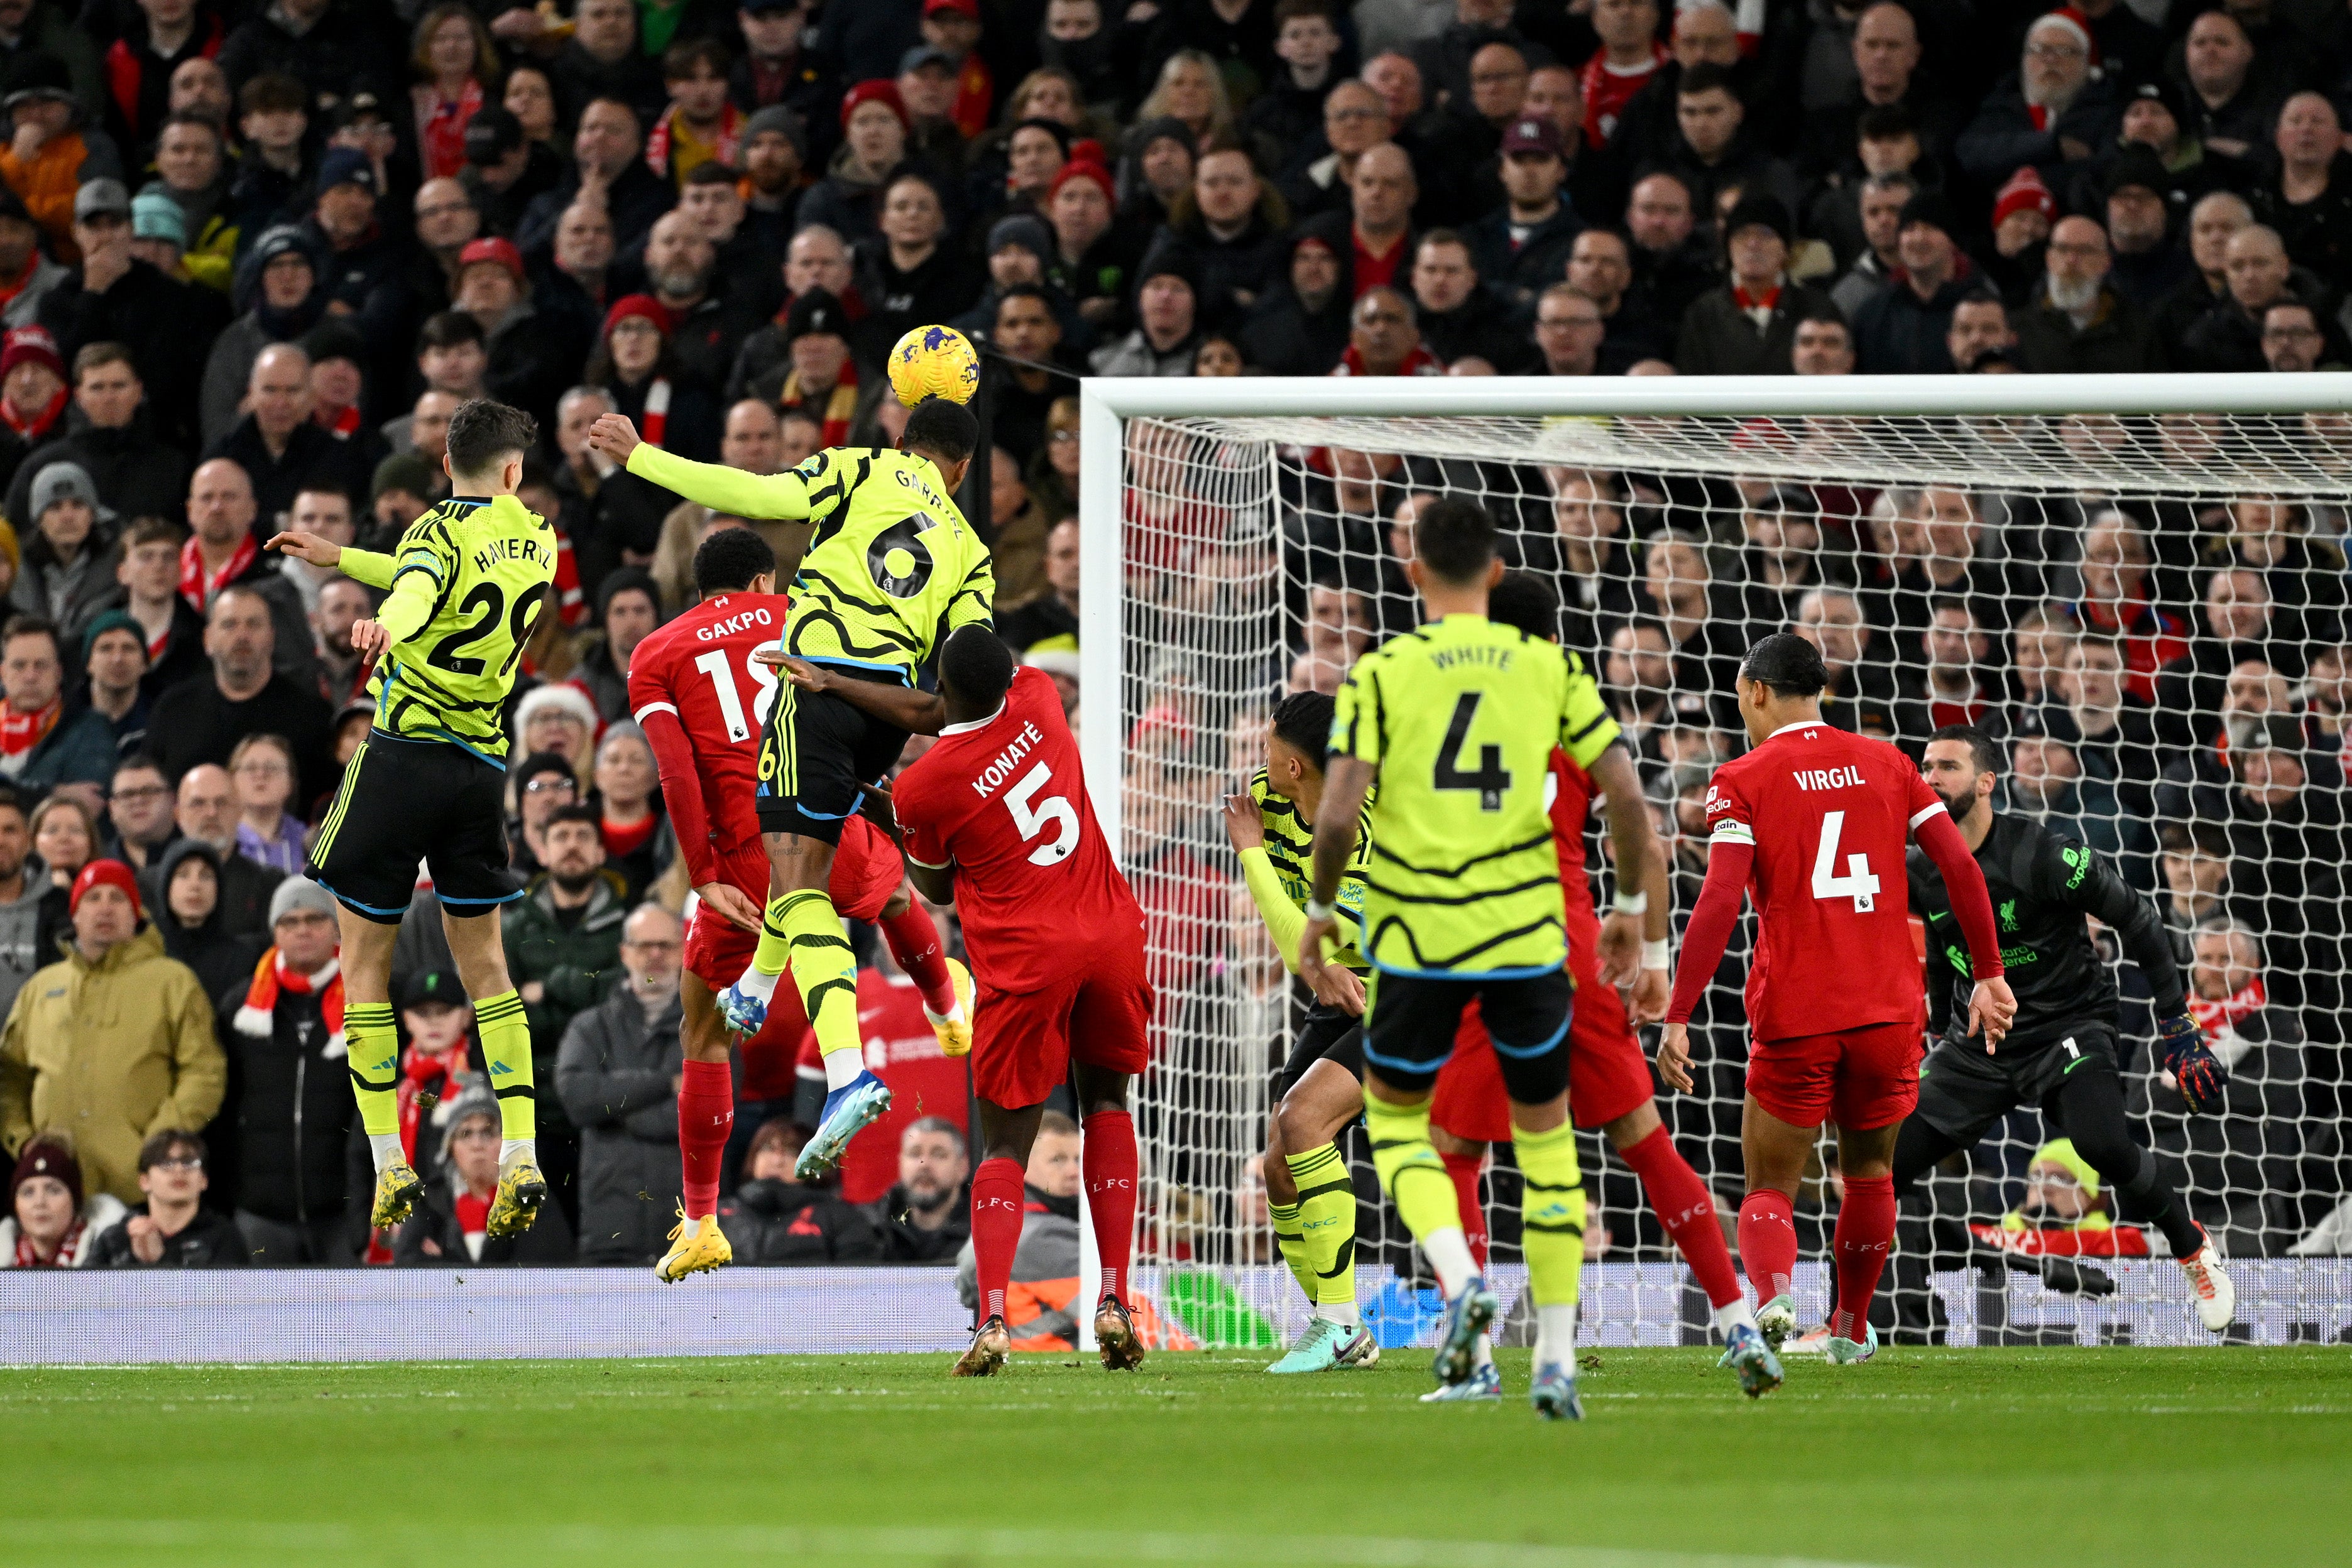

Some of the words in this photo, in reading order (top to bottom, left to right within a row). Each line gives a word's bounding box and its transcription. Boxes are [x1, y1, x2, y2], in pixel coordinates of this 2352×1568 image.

[895, 470, 965, 540] GABREL
[474, 539, 551, 574] HAVERTZ
[867, 511, 938, 599] 6
[427, 581, 550, 677] 29
[696, 608, 772, 641] GAKPO
[1430, 646, 1512, 672] WHITE
[757, 737, 776, 781] 6
[971, 720, 1043, 798] KONATÉ
[1434, 691, 1511, 810] 4
[1793, 765, 1866, 791] VIRGIL
[1003, 760, 1080, 867] 5
[1811, 810, 1880, 913] 4
[2066, 846, 2091, 890] Expedia
[1348, 882, 1364, 895] VIS
[2002, 923, 2020, 933] LFC
[901, 943, 936, 964] LFC
[2062, 1037, 2081, 1059] 1
[713, 1106, 734, 1126] LF
[1093, 1179, 1129, 1193] LFC
[976, 1197, 1015, 1212] LFC
[1668, 1202, 1708, 1229] LFC
[1303, 1216, 1337, 1229] AFC
[1752, 1212, 1793, 1231] LFC
[1468, 1233, 1489, 1248] FC
[1844, 1241, 1887, 1252] LFC
